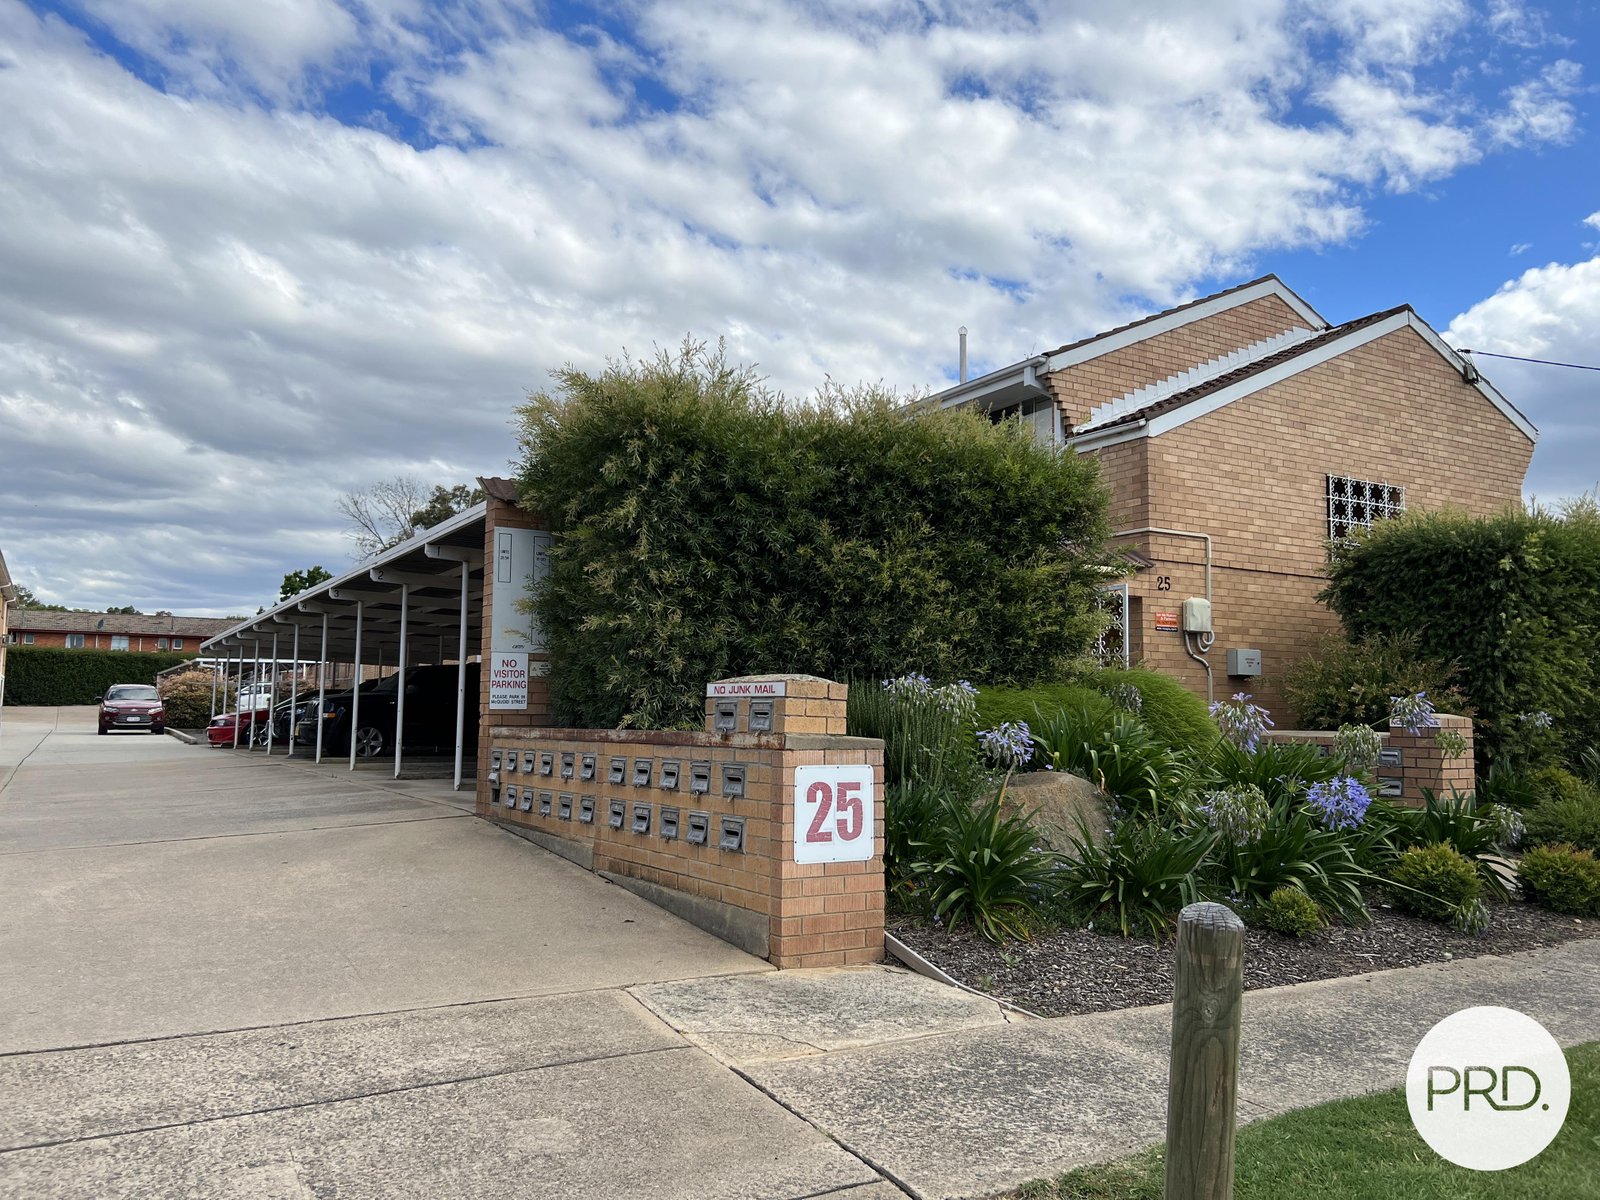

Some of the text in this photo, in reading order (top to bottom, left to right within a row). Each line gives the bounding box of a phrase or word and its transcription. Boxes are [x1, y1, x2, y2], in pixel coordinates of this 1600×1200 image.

[377, 570, 384, 580] 2
[1157, 576, 1171, 591] 25
[333, 589, 340, 598] 3
[301, 603, 307, 611] 4
[502, 659, 517, 668] NO
[494, 669, 525, 678] VISITOR
[491, 680, 527, 689] PARKING
[714, 684, 776, 695] NO JUNK MAIL
[806, 781, 863, 842] 25
